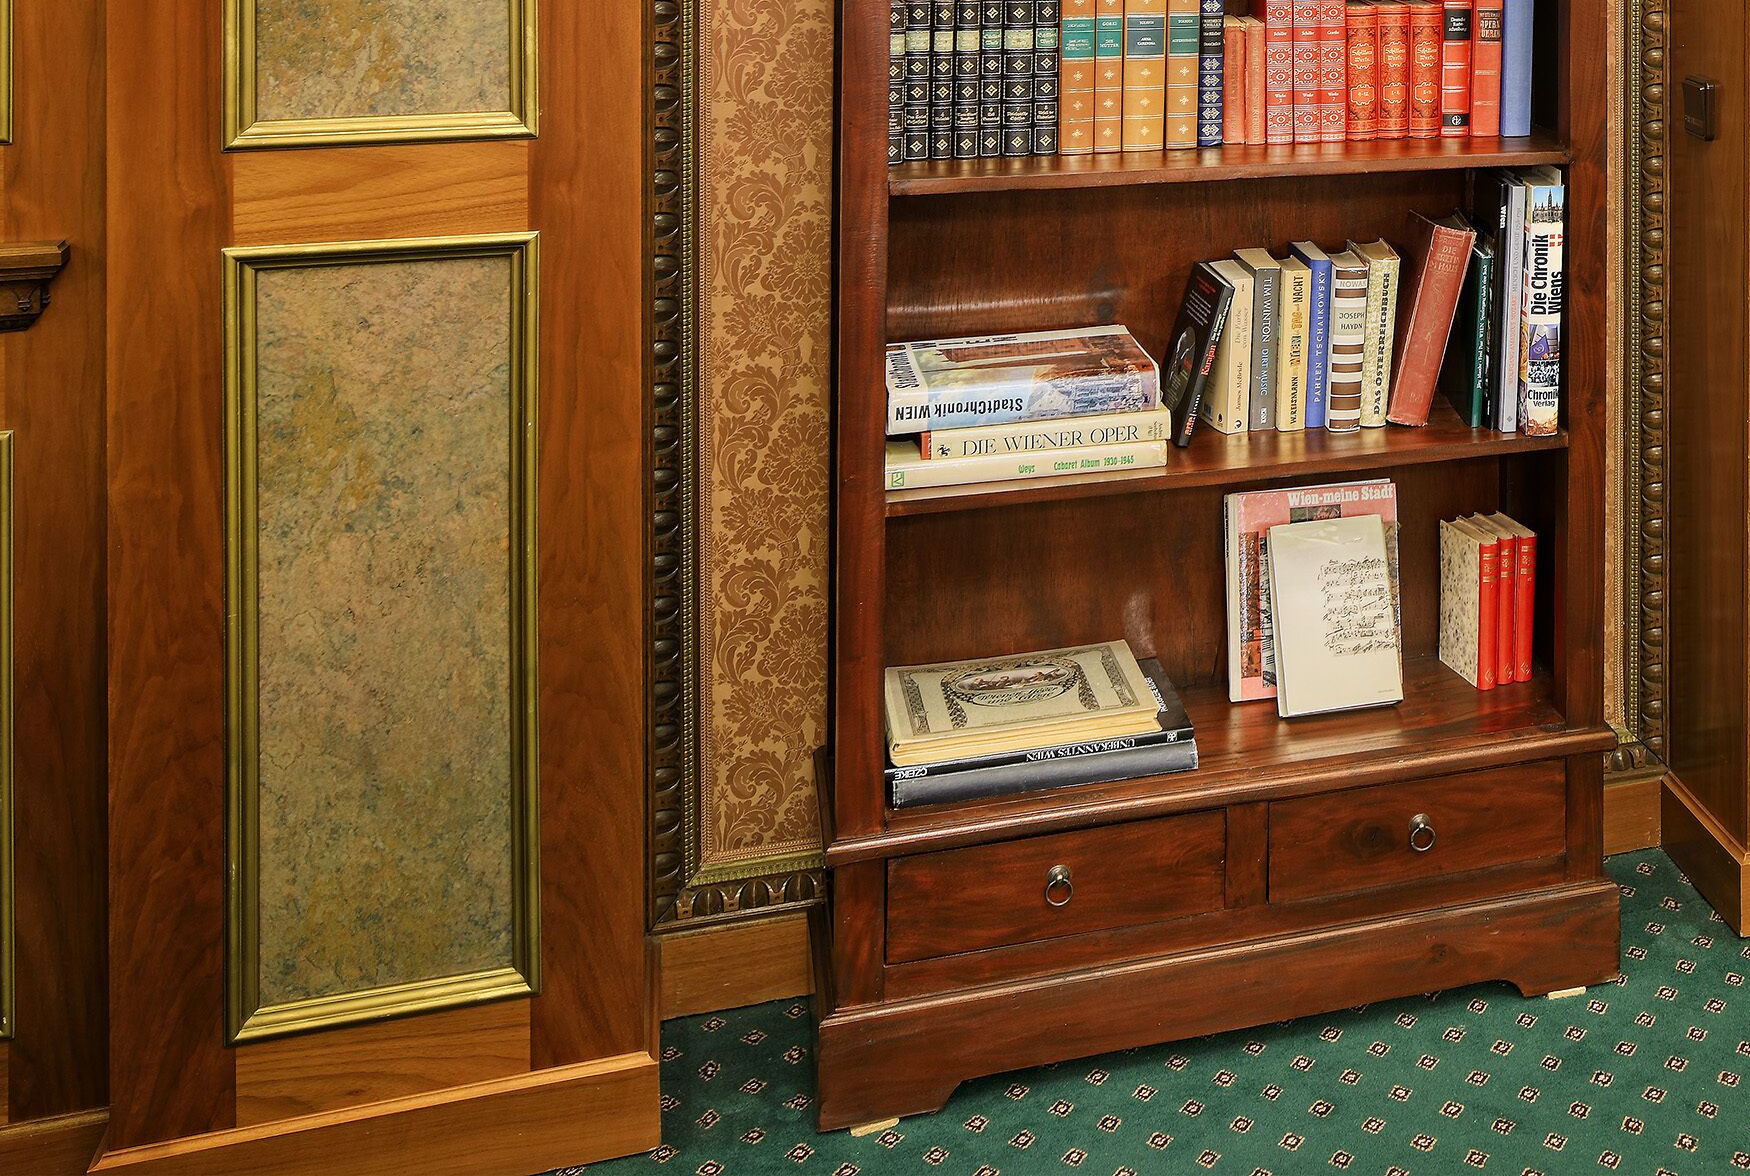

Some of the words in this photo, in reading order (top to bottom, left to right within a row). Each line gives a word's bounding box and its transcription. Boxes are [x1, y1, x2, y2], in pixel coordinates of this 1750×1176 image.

[1499, 205, 1507, 229] Wien
[1531, 234, 1549, 290] Chronik
[1263, 277, 1273, 298] TIM
[1292, 275, 1304, 304] NACHT
[1548, 271, 1562, 315] Wiens
[1315, 271, 1326, 356] TSCHAIKOWSKY
[1339, 312, 1365, 320] JOSEPH
[1531, 292, 1547, 315] Die
[1261, 299, 1272, 344] WINTON
[1200, 344, 1217, 376] Karajan
[1261, 347, 1269, 367] DIRT
[1260, 369, 1269, 396] MUSIC
[1314, 361, 1322, 403] PAHLEN
[934, 398, 1023, 418] StadtChronik
[1235, 386, 1243, 412] James
[1373, 389, 1382, 415] DAS
[895, 404, 931, 421] WIEN
[963, 438, 997, 456] DIE
[1003, 430, 1083, 451] WIENER
[1090, 424, 1139, 444] OPER
[1018, 464, 1036, 474] Weys
[1053, 461, 1078, 471] Cabaret
[1080, 458, 1100, 469] Album
[1361, 485, 1393, 501] Stadt
[1026, 749, 1056, 762] WIEN
[1057, 738, 1136, 758] UNBEKANNTES
